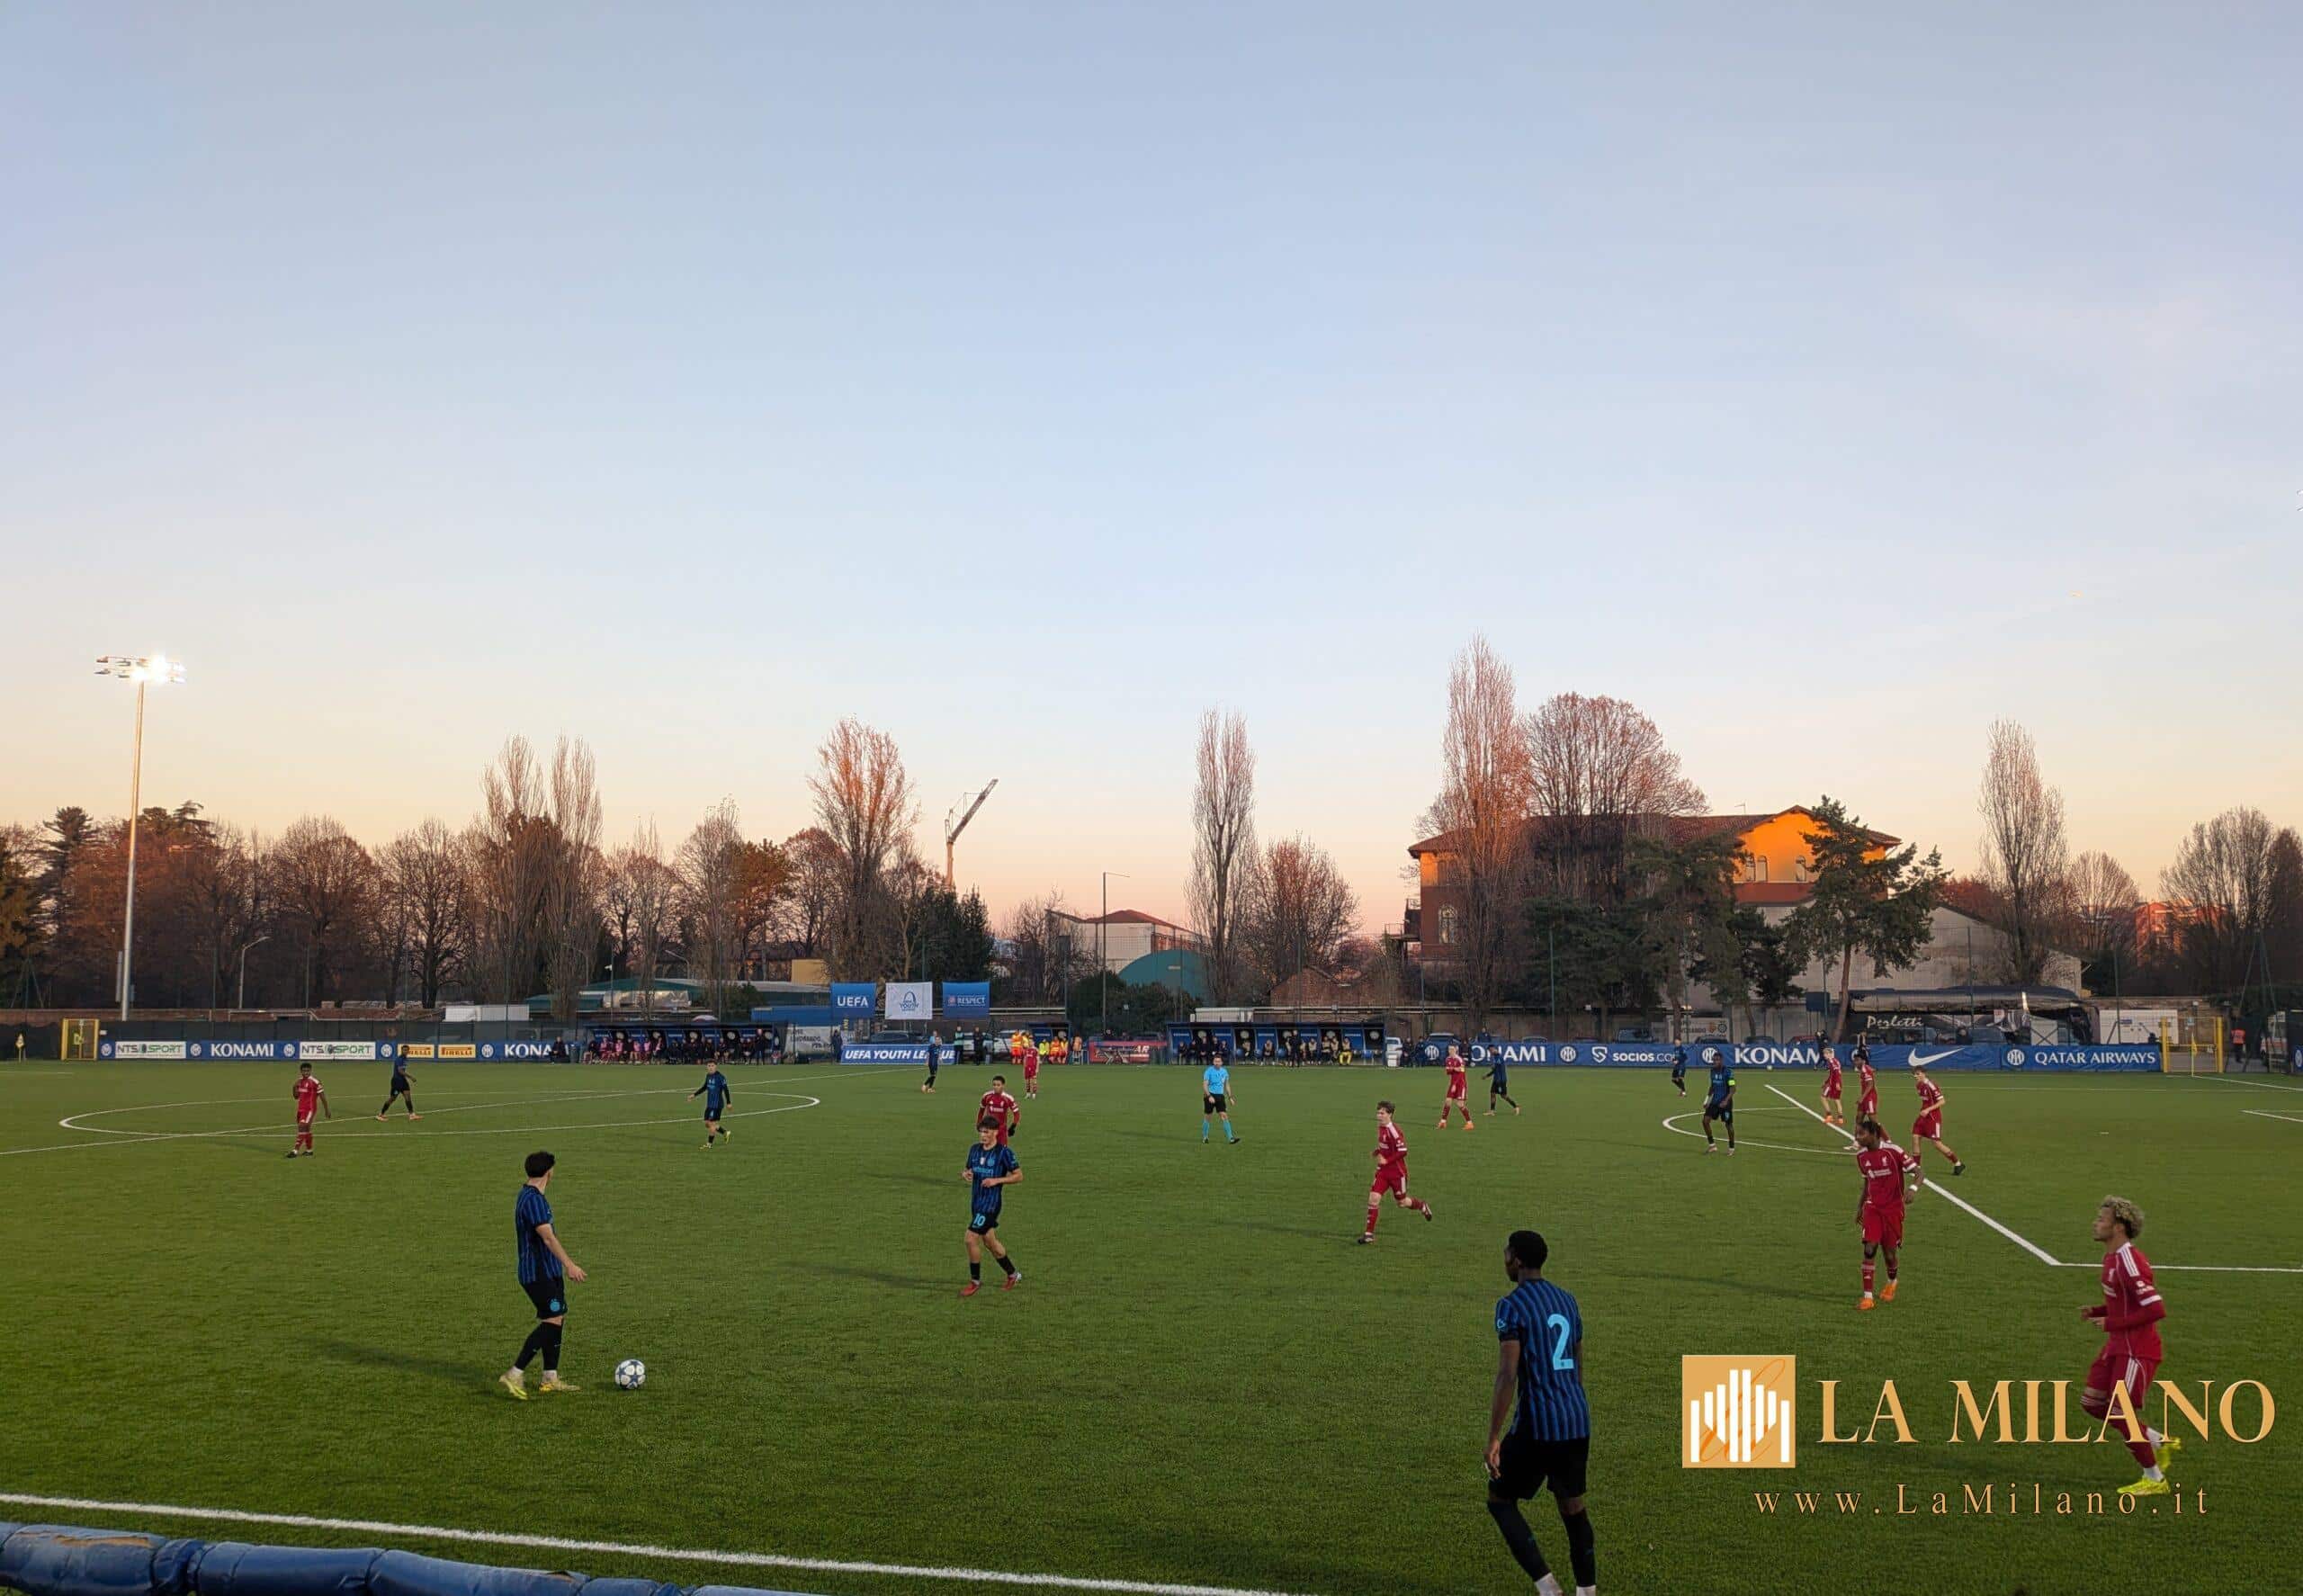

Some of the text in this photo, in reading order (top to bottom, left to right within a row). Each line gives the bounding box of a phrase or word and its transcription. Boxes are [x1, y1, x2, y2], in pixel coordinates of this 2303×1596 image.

[837, 996, 869, 1007] UEFA
[117, 1044, 184, 1054] NTS SPORT
[211, 1044, 274, 1057] KONAMI
[301, 1045, 372, 1054] NTS SPORT
[505, 1044, 569, 1058] KONA
[845, 1050, 955, 1060] UEFA YOUTH LEUE
[1734, 1047, 1820, 1064] KONAM
[1612, 1053, 1675, 1062] SOCIOS.CO
[2035, 1052, 2155, 1065] QATAR AIRWAYS
[973, 1213, 986, 1226] 10
[1547, 1314, 1574, 1370] 2
